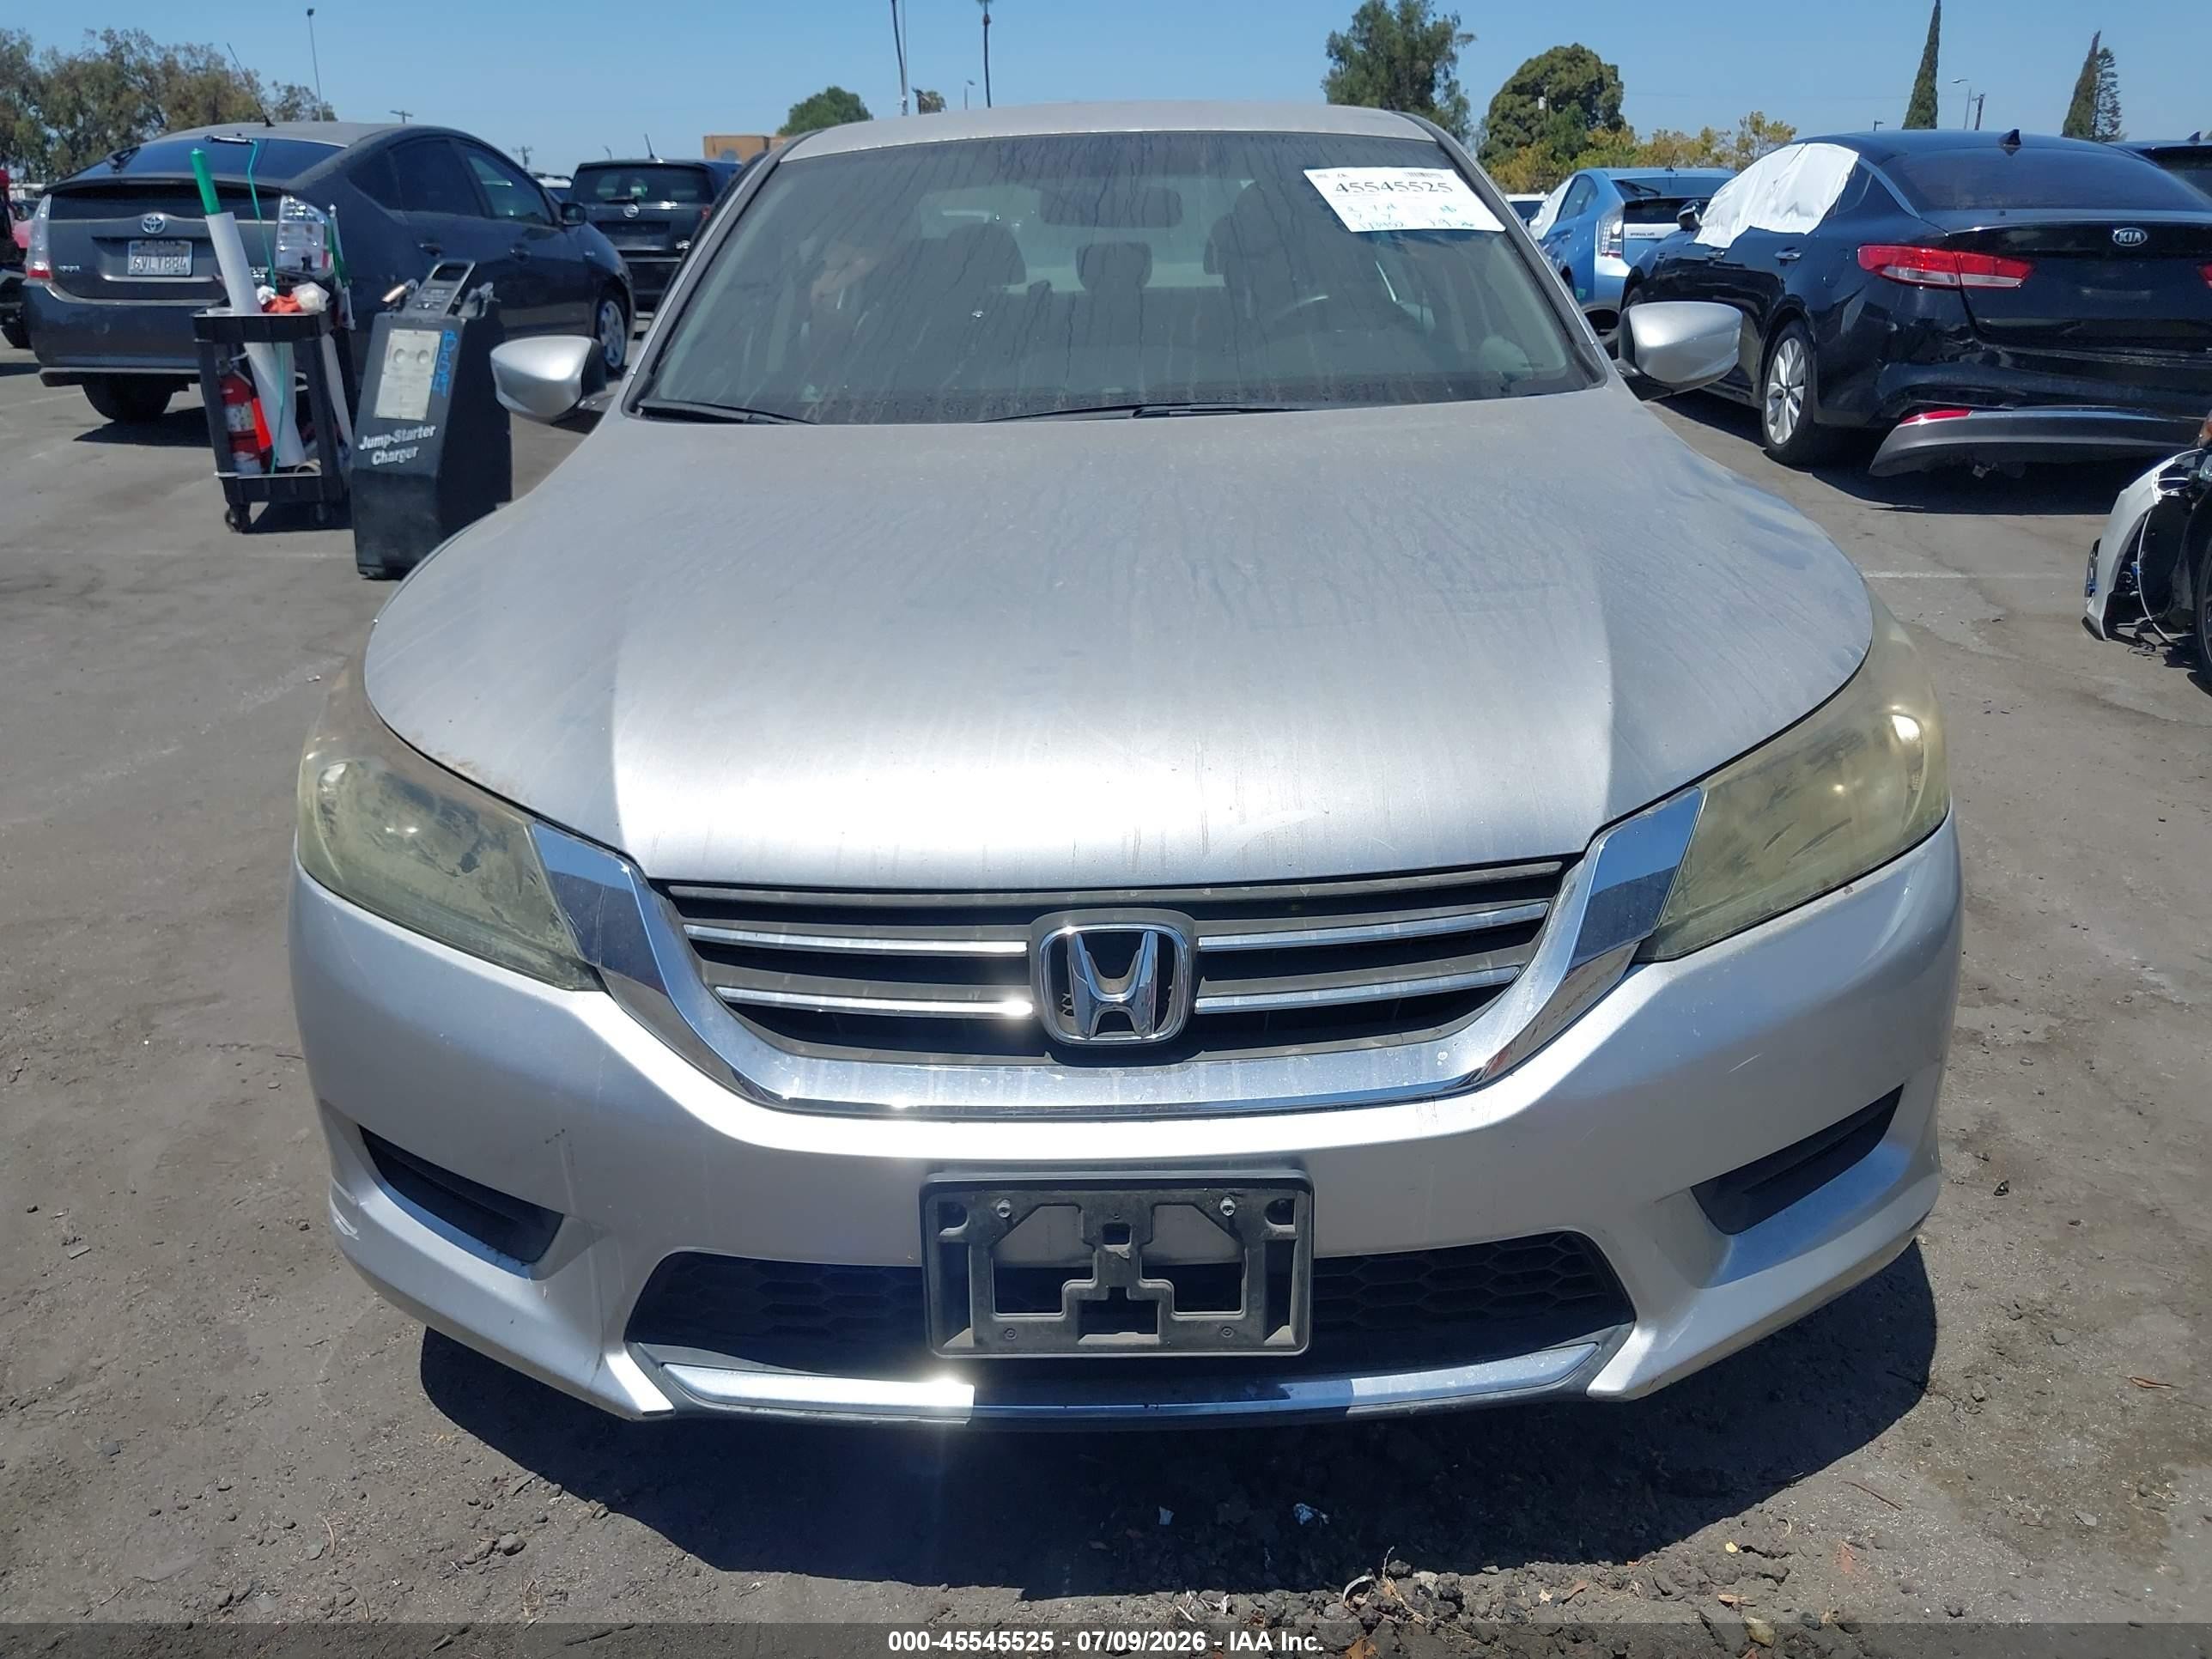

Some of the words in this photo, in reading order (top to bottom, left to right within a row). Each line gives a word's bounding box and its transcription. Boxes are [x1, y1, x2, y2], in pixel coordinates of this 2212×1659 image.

[1334, 180, 1454, 193] 45545525
[2118, 231, 2142, 242] KIA
[358, 424, 436, 451] Jump-Starter
[371, 447, 419, 465] Charger
